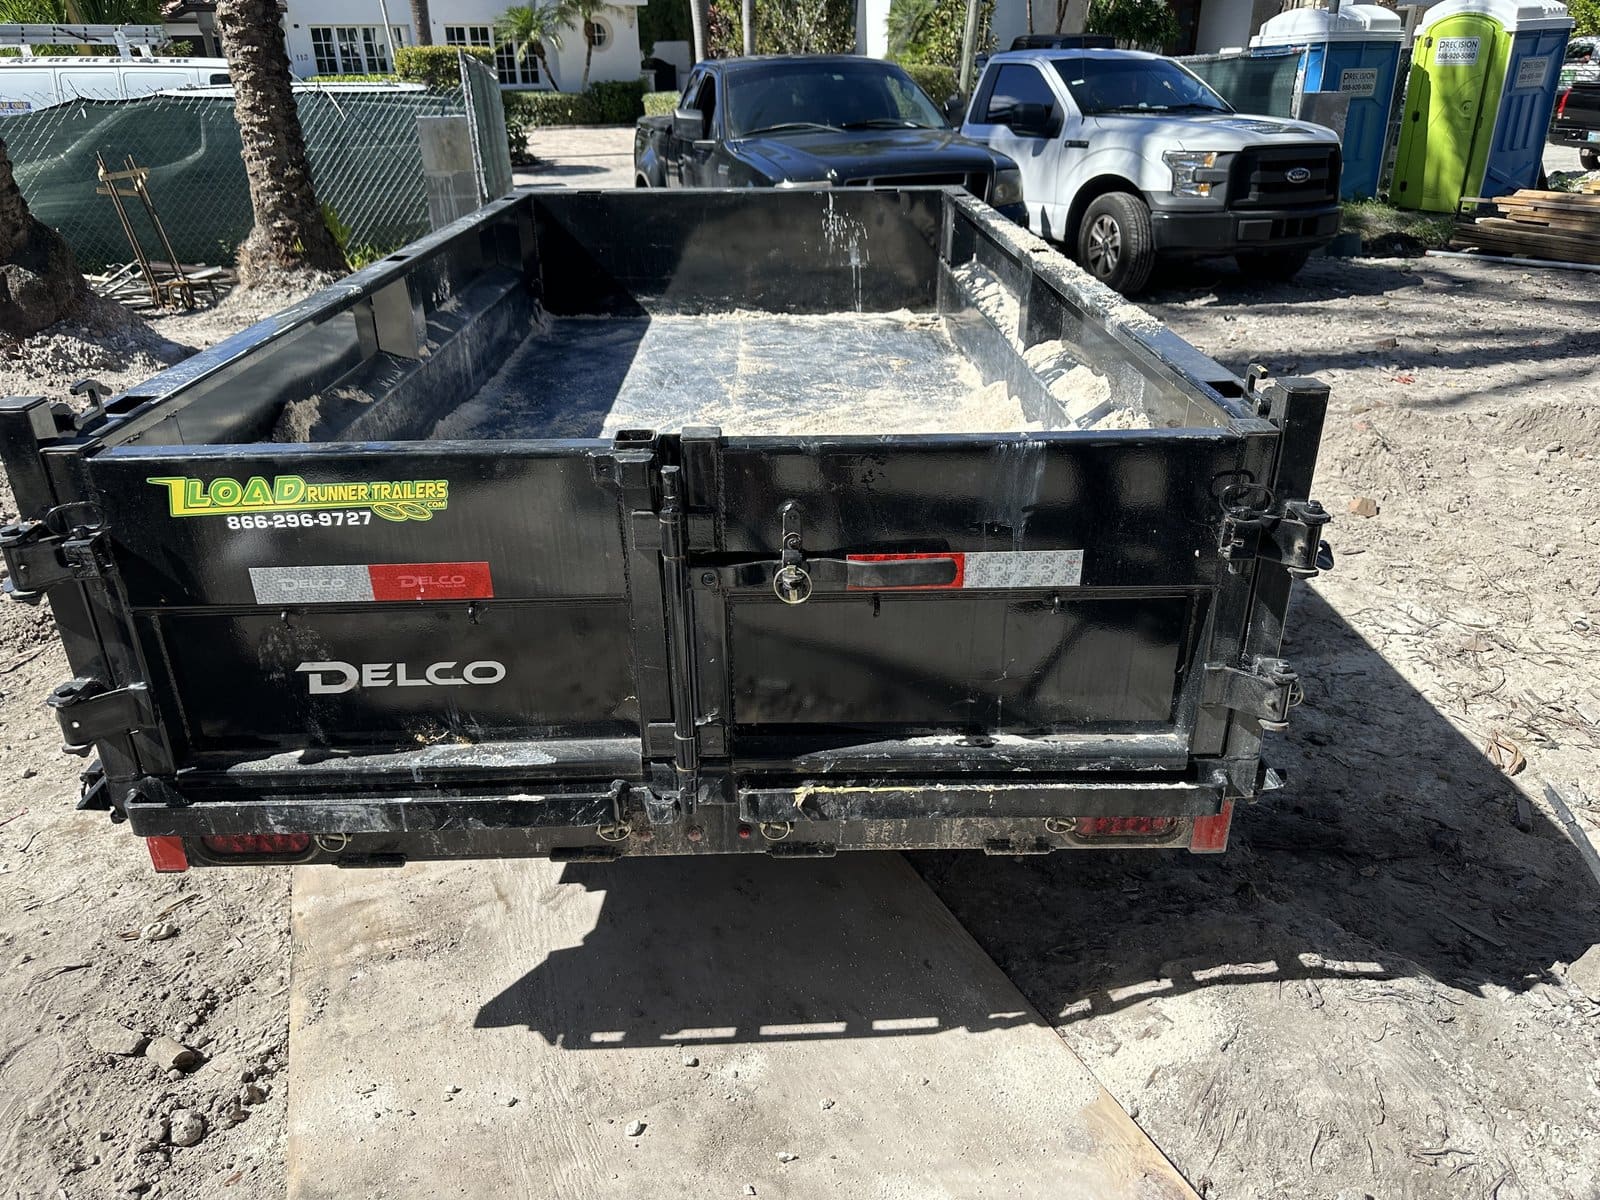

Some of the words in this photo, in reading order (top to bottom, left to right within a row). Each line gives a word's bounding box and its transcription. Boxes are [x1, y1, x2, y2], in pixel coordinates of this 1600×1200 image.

[1438, 40, 1478, 51] PRECISION
[306, 485, 370, 502] RUNNER
[370, 481, 448, 499] TRAILERS
[226, 511, 372, 530] 866-296-9727
[398, 575, 466, 588] DELCO
[295, 660, 506, 695] DELCO
